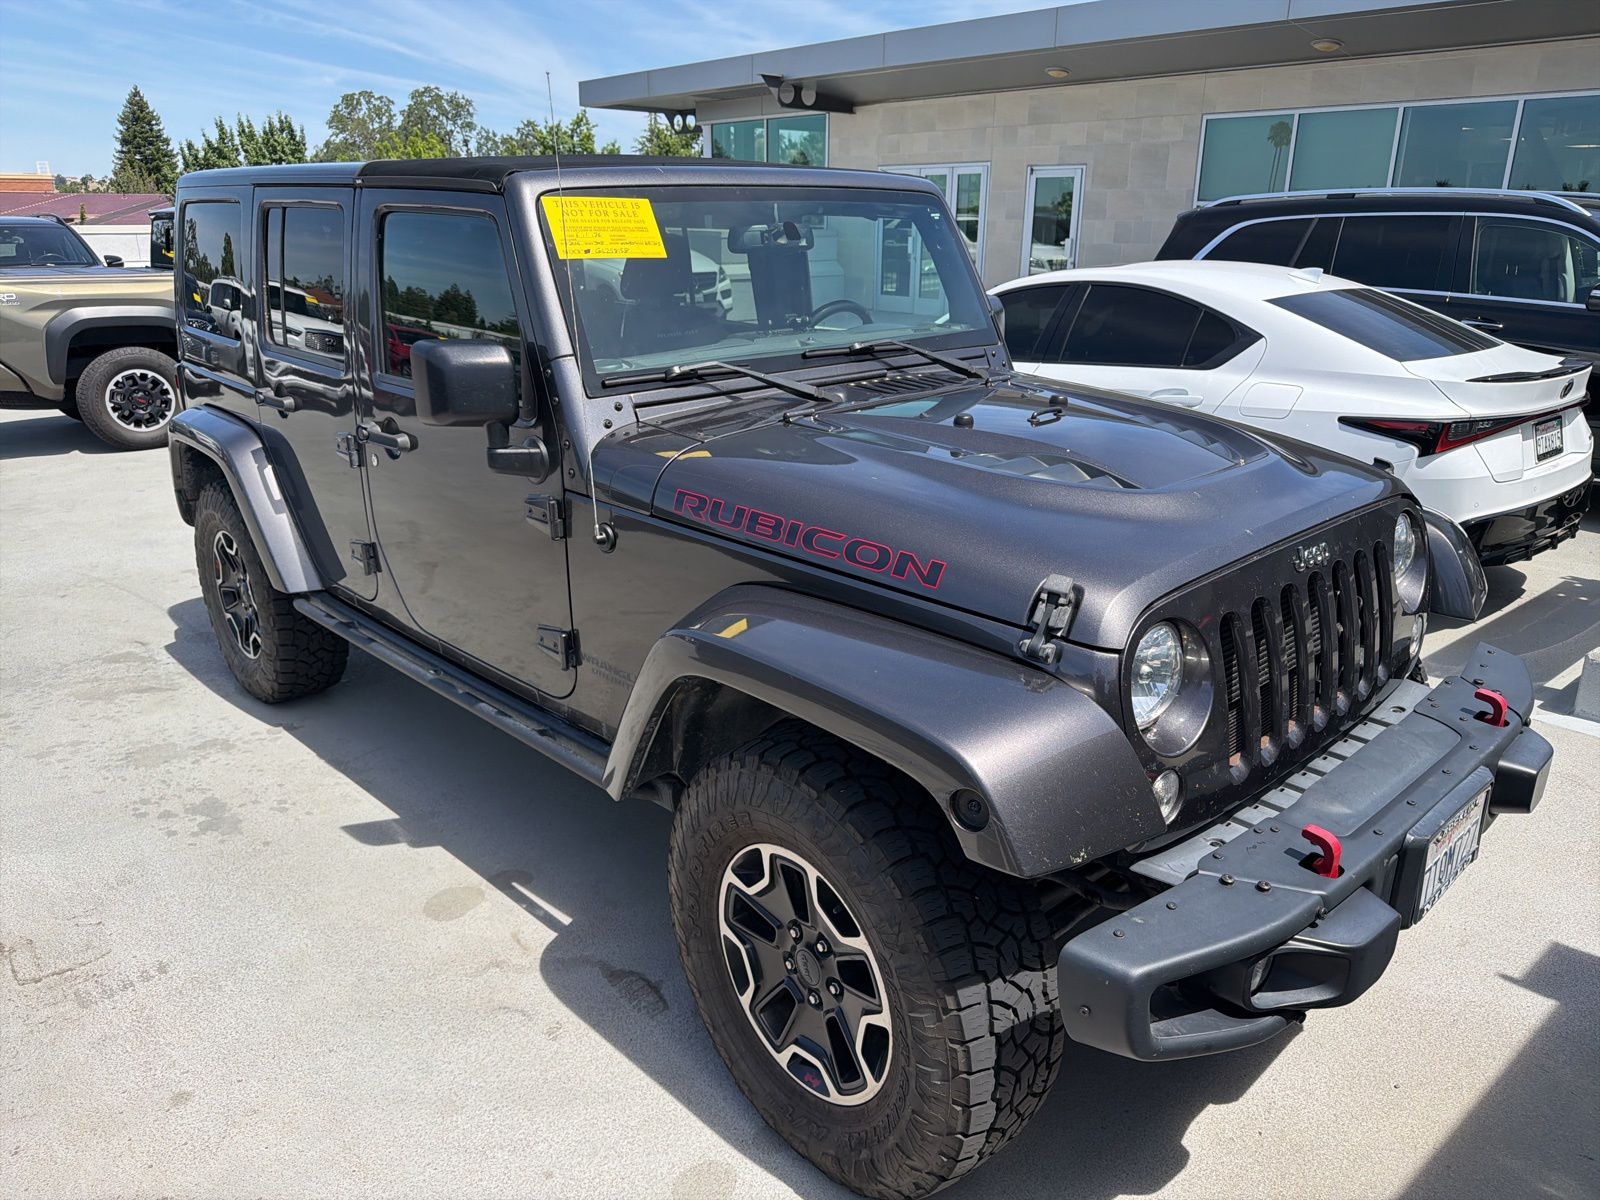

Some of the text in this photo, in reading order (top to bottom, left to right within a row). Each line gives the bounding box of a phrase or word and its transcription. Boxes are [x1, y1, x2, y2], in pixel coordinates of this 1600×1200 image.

[563, 209, 584, 217] NOT
[588, 209, 610, 217] FOR
[673, 488, 947, 590] RUBICON
[1292, 542, 1330, 572] Jeep
